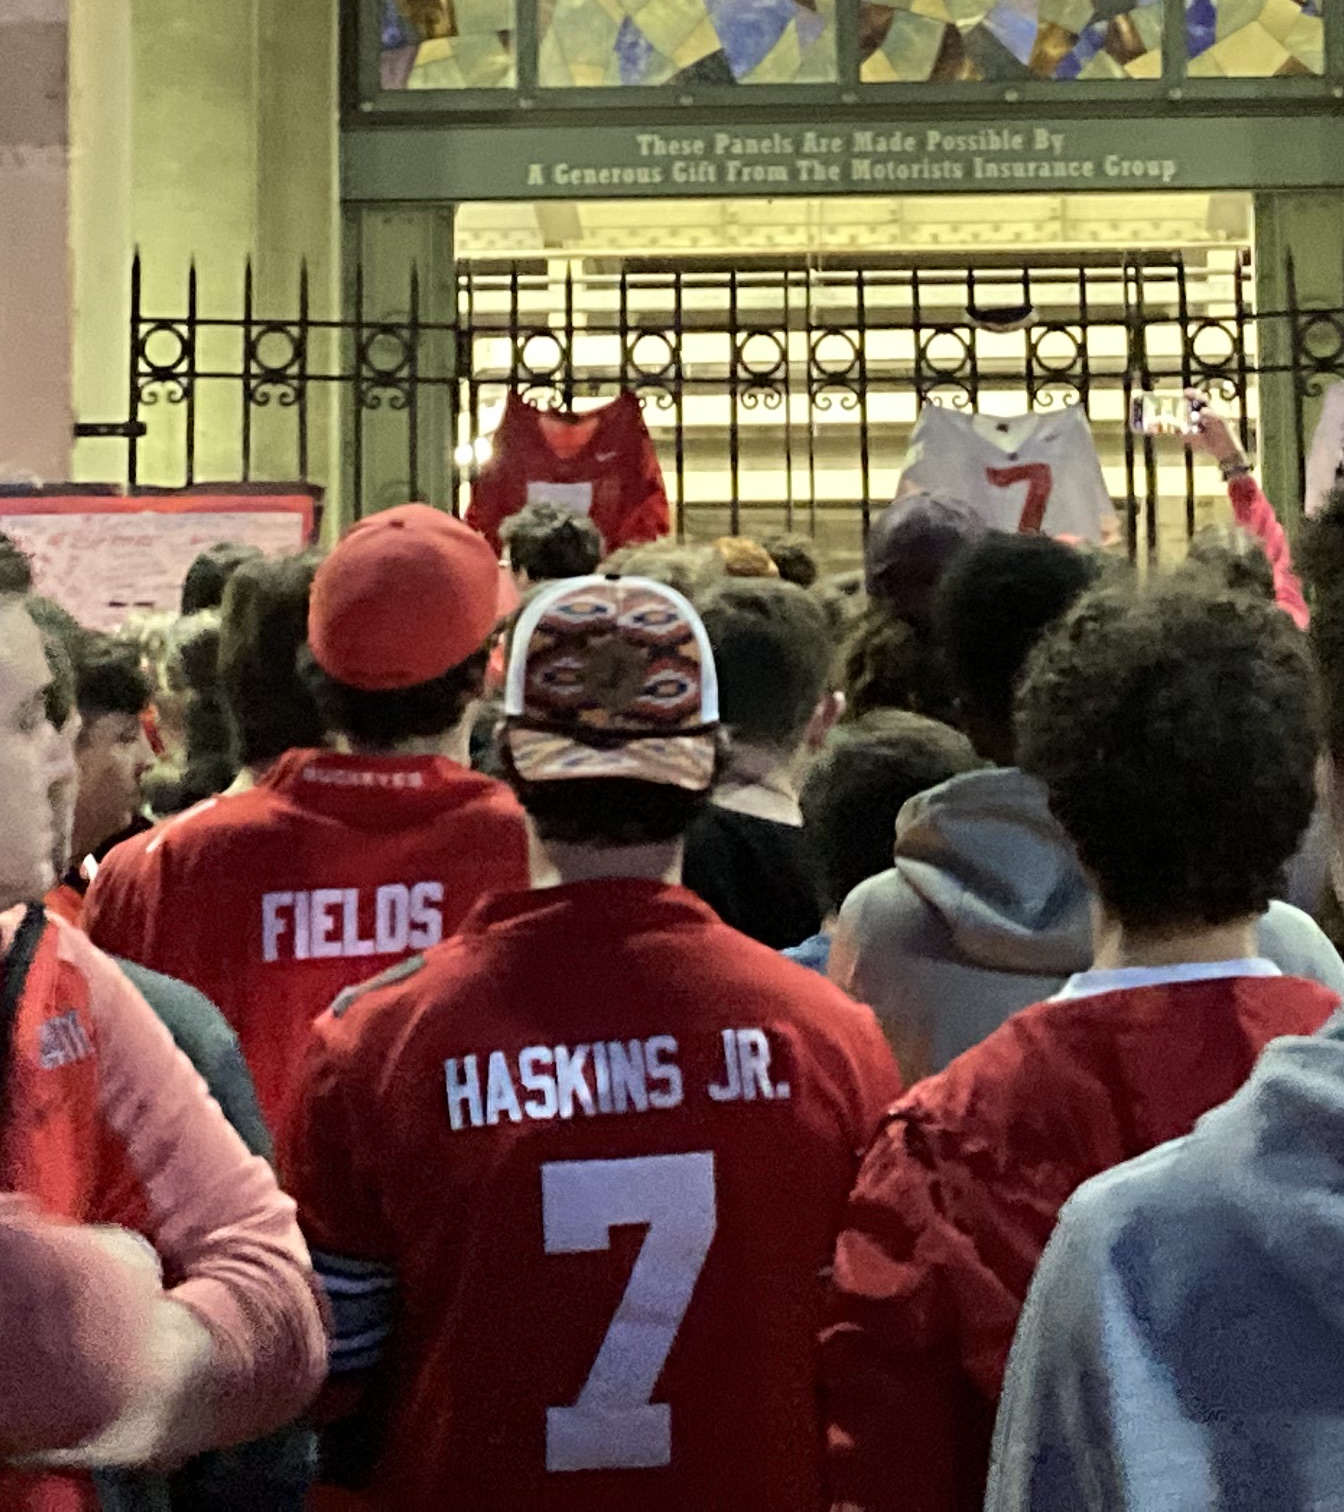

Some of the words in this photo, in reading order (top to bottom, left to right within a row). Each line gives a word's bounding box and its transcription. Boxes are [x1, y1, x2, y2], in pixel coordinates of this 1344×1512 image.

[527, 164, 545, 185] A
[555, 163, 662, 185] Generous
[672, 160, 717, 183] Gift
[726, 160, 789, 182] From
[796, 159, 841, 181] The
[851, 158, 963, 180] Motorists
[973, 157, 1094, 179] Insurance
[1105, 154, 1176, 182] Group
[636, 133, 705, 155] These
[714, 133, 793, 155] Panels
[803, 131, 843, 154] Are
[853, 131, 917, 153] Made
[927, 128, 1024, 151] Possible
[1034, 127, 1064, 156] By
[985, 462, 1053, 534] 7
[262, 881, 444, 962] FIELDS
[445, 1035, 683, 1130] HASKINS
[709, 1028, 790, 1101] JR.
[541, 1150, 718, 1472] 7
